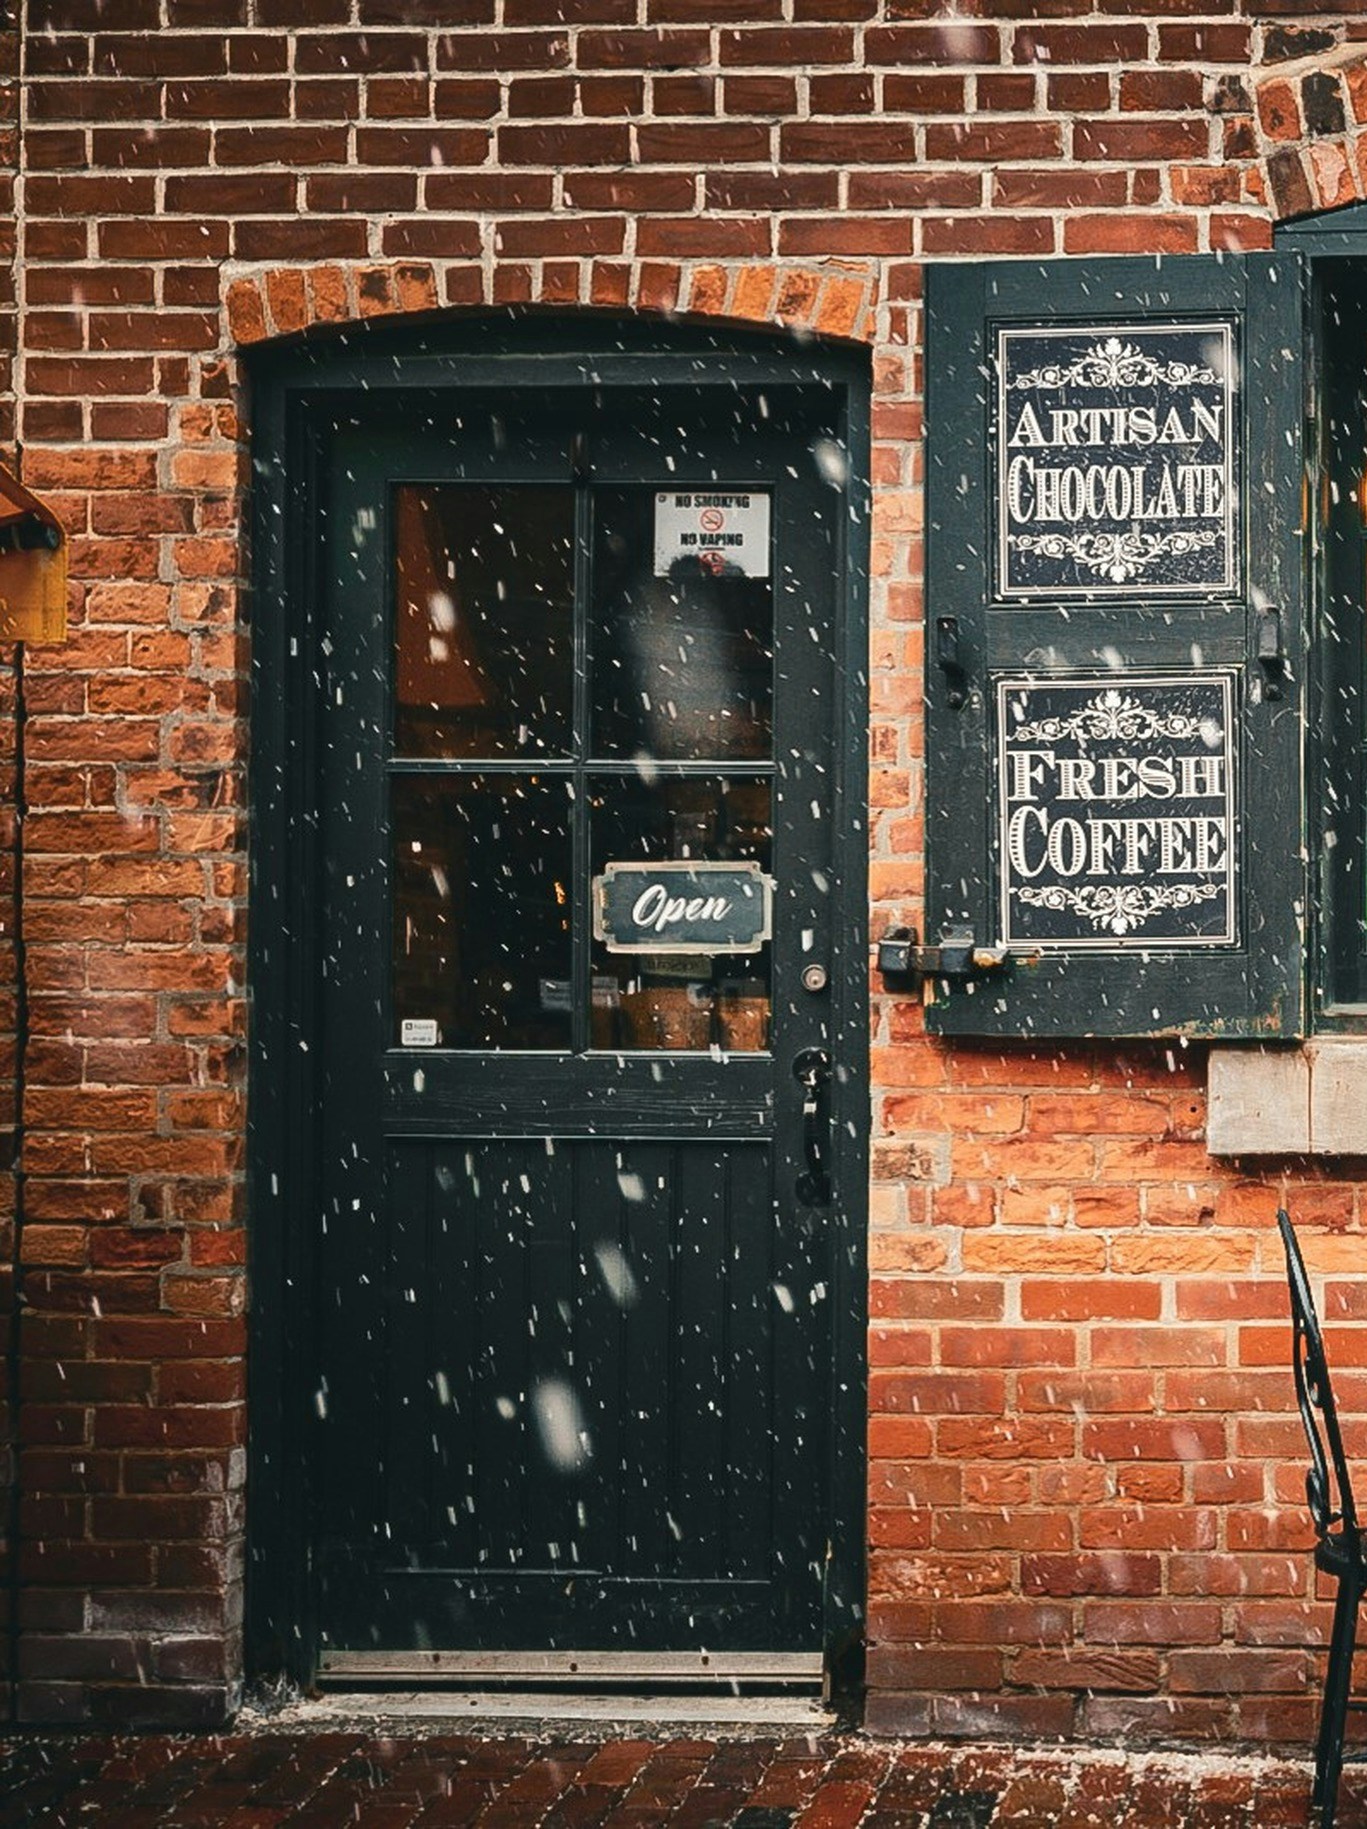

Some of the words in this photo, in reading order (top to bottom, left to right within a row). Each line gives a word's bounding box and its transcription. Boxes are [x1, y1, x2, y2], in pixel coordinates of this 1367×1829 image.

[1007, 401, 1223, 448] ARTISAN
[675, 495, 692, 508] NO
[1007, 454, 1224, 524] CHOCOLATE
[680, 533, 697, 546] NO
[699, 533, 743, 546] VAPING
[1008, 751, 1225, 801] FRESH
[1009, 805, 1227, 877] COFFEE
[632, 884, 733, 933] Open
